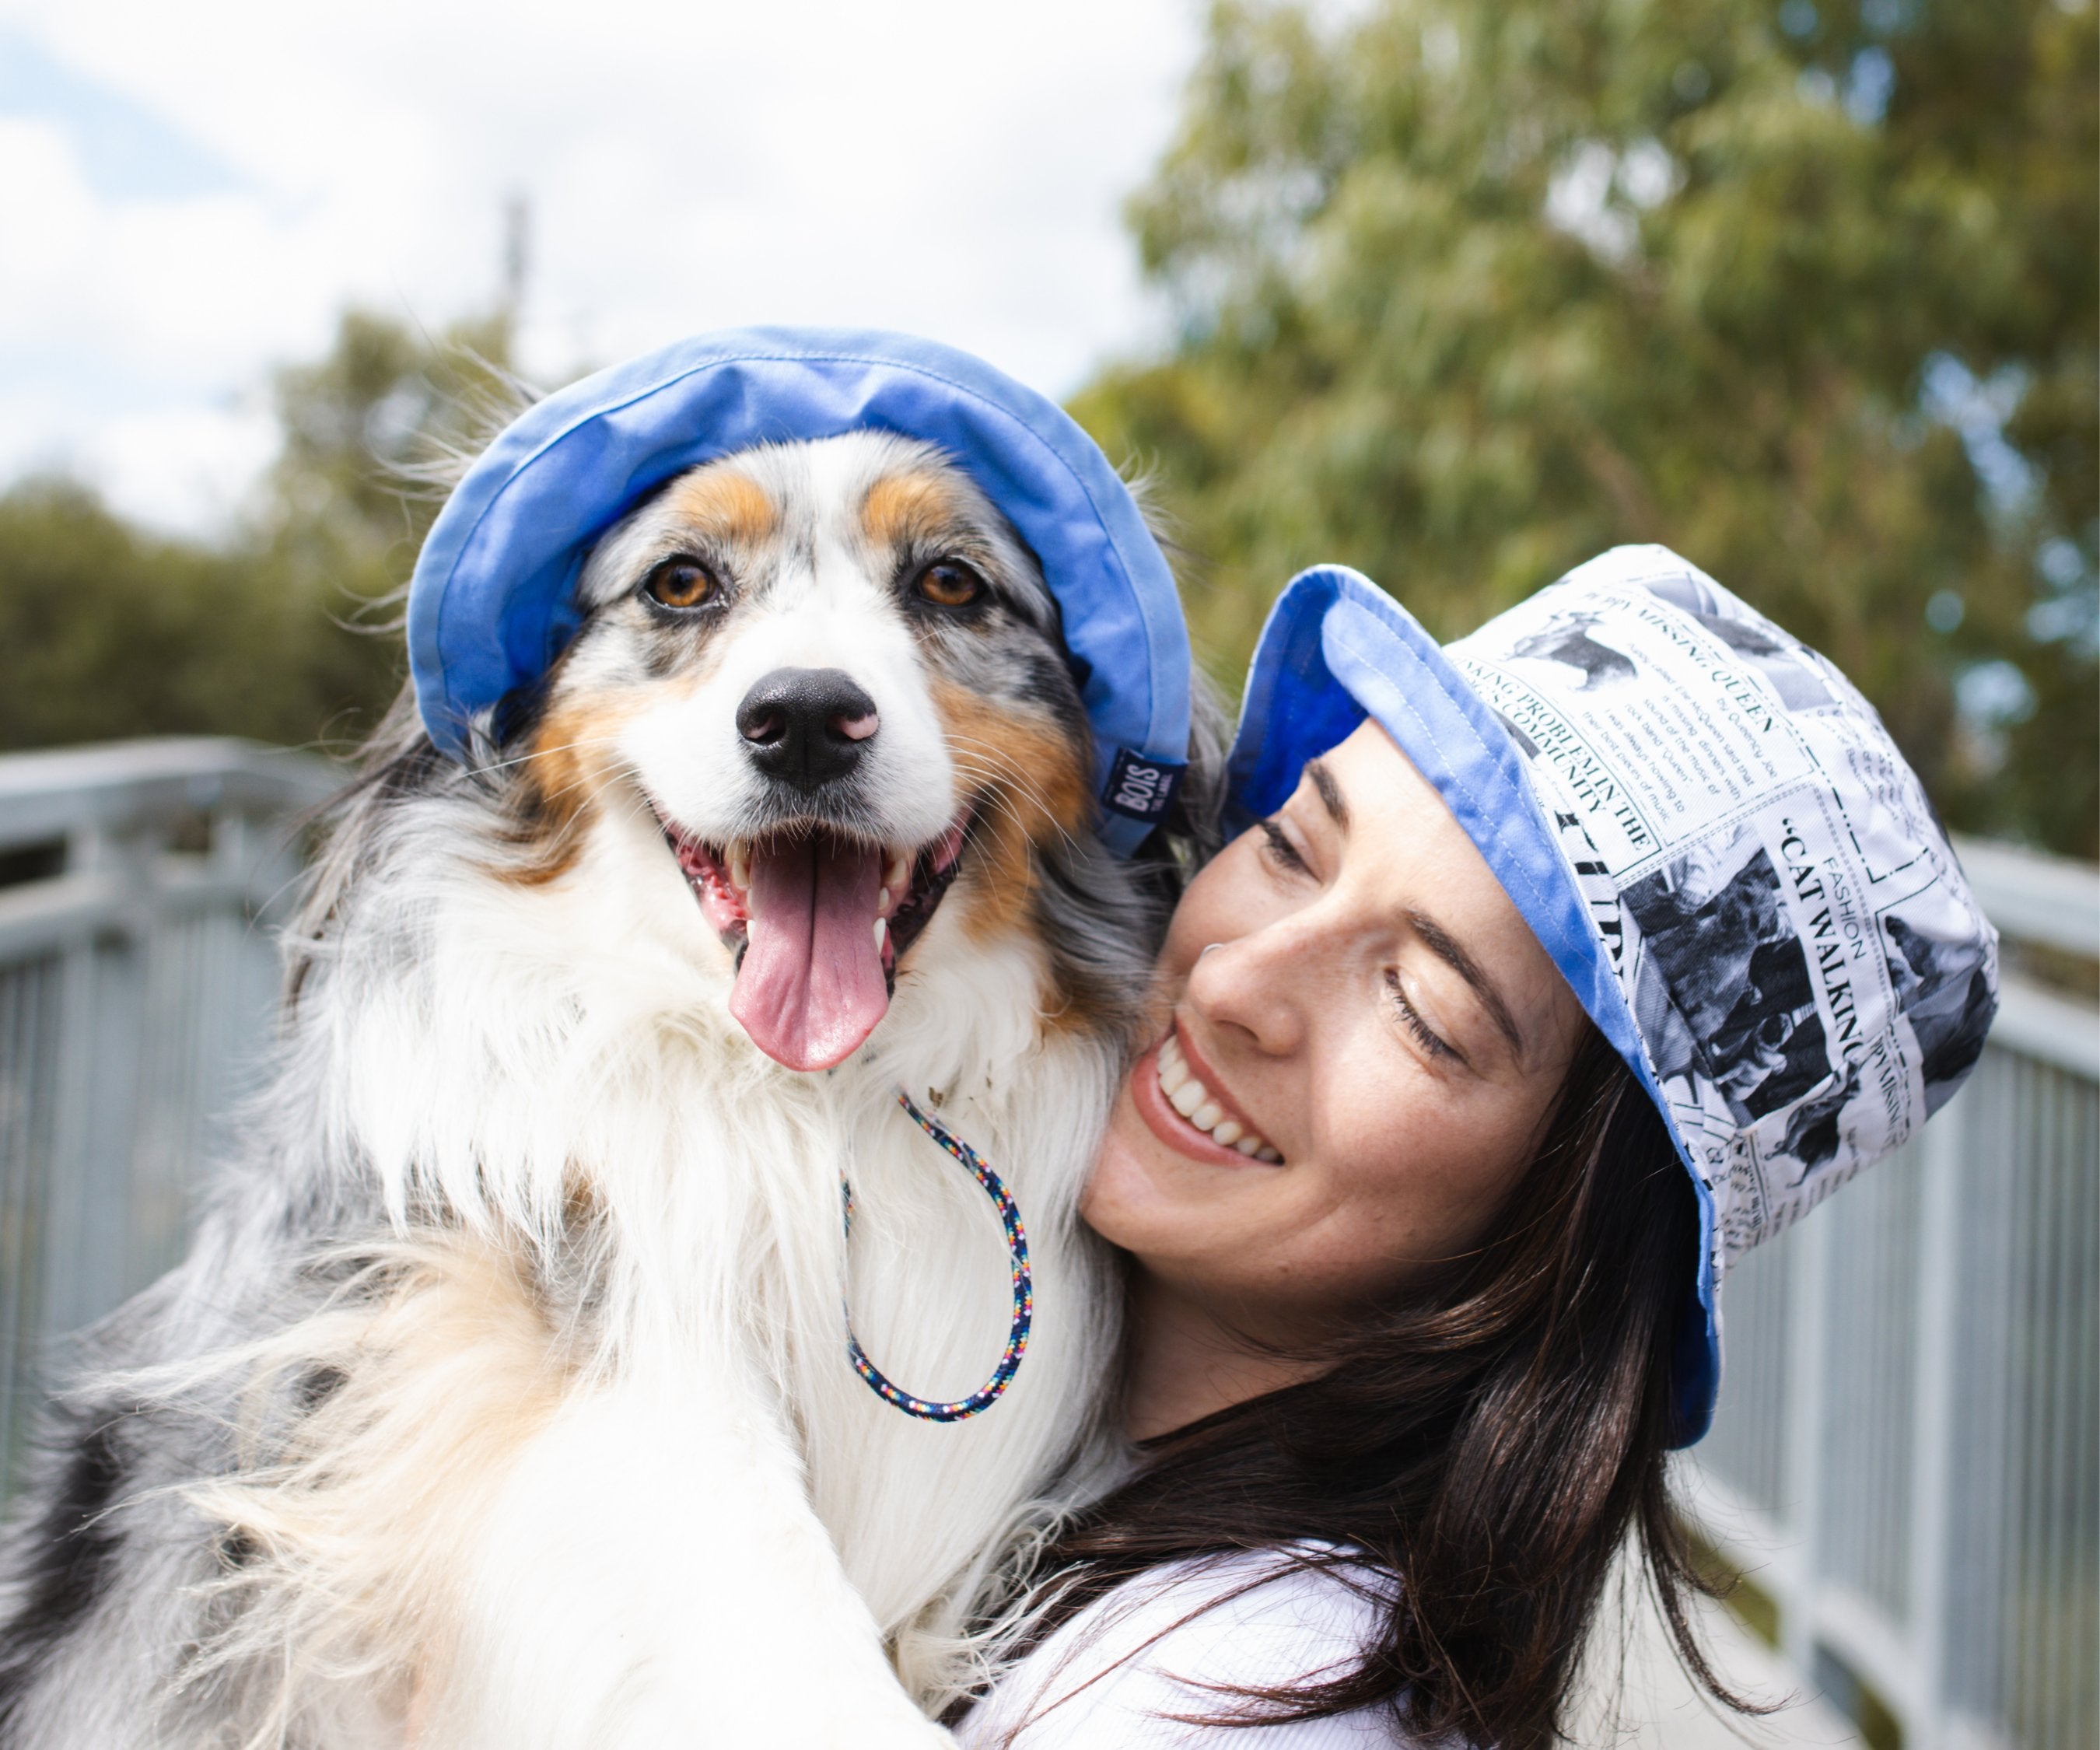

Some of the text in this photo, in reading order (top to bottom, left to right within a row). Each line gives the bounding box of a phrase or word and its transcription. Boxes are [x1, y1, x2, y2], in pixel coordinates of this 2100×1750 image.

[1624, 704, 1642, 722] rock
[1641, 722, 1663, 746] band
[1711, 670, 1773, 732] QUEEN
[1716, 697, 1729, 712] by
[1761, 761, 1777, 778] Joe
[1115, 765, 1159, 810] BOIS
[1503, 705, 1605, 812] COMMUNITY
[1517, 694, 1599, 775] PROBLEM
[1594, 777, 1619, 801] IN
[1615, 807, 1650, 849] THE
[1582, 711, 1601, 730] their
[1600, 730, 1619, 751] best
[1615, 752, 1640, 780] pieces
[1639, 781, 1653, 791] of
[1608, 714, 1623, 730] was
[1623, 732, 1648, 761] always
[1648, 761, 1677, 800] howling
[1673, 799, 1685, 813] to
[1643, 698, 1720, 795] sound of the music of
[1672, 704, 1697, 737] missing
[1698, 740, 1726, 775] dinners
[1724, 778, 1741, 800] with
[1723, 743, 1740, 764] said
[1737, 765, 1754, 786] that
[1824, 857, 1866, 960] FASHION
